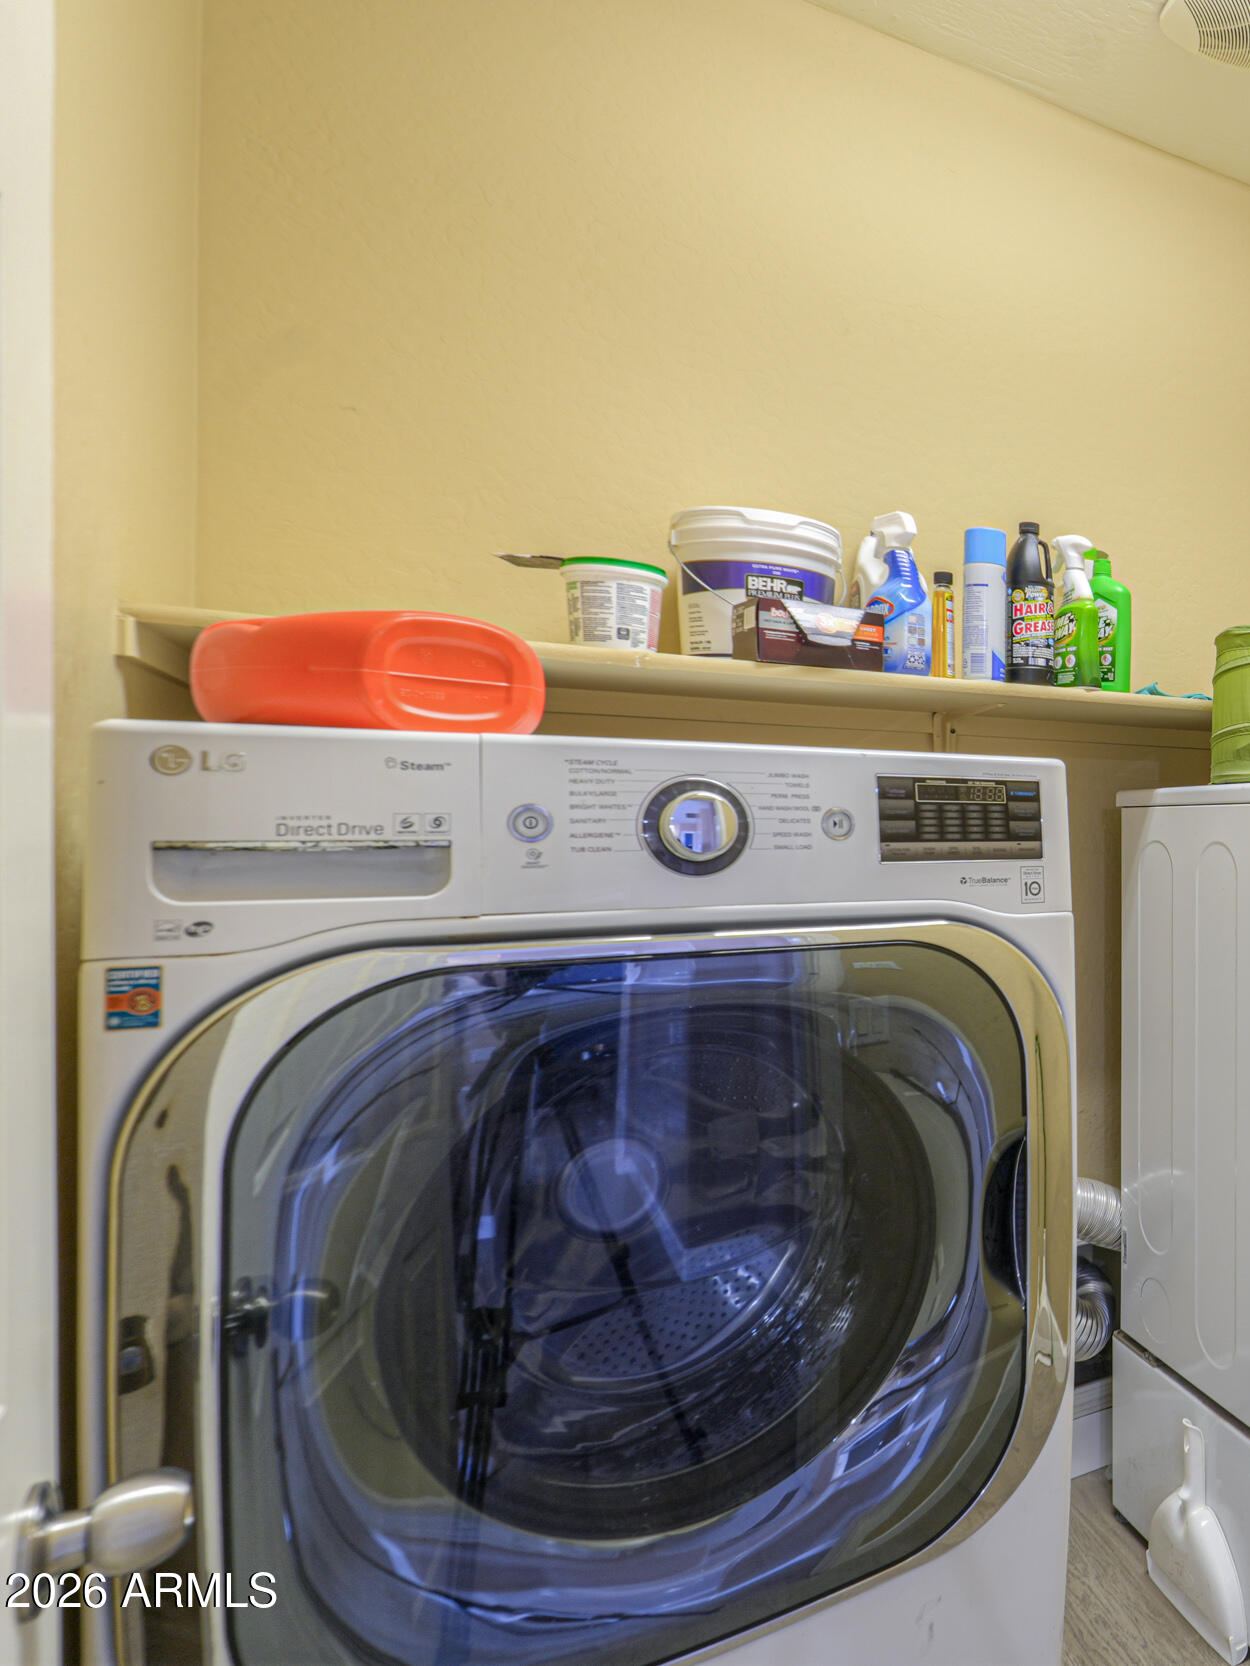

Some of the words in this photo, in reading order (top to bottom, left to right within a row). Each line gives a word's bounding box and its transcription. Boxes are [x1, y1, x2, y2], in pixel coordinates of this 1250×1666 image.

[747, 575, 787, 593] BEHR
[1013, 602, 1046, 618] HAIR
[1013, 620, 1054, 636] GREASE
[200, 750, 248, 773] LG
[275, 822, 333, 837] Direct
[336, 822, 385, 836] Drive
[1025, 880, 1042, 896] 10
